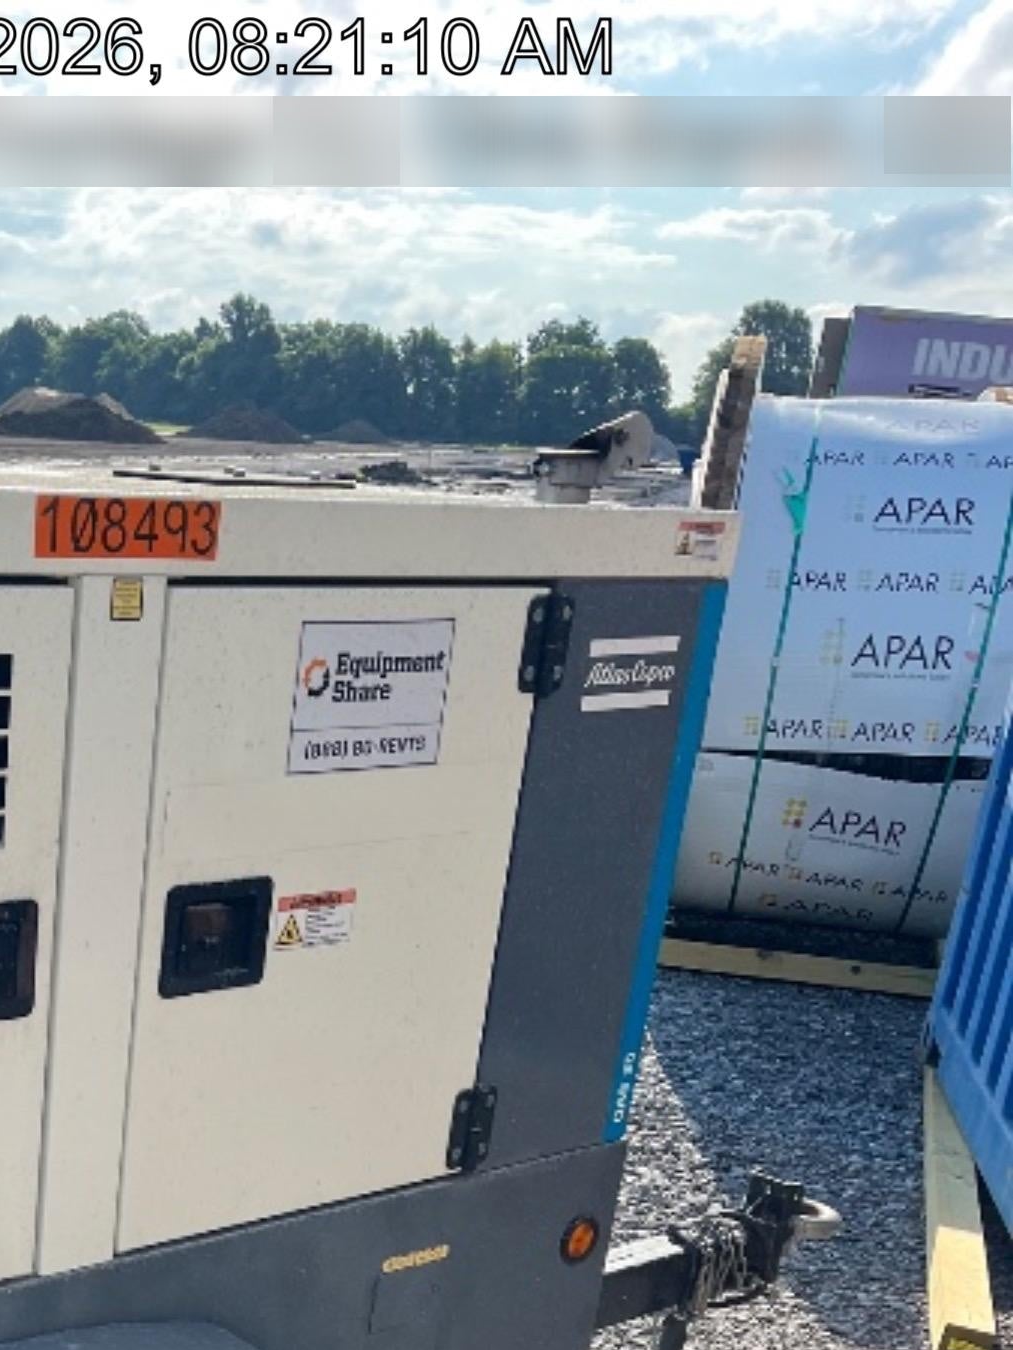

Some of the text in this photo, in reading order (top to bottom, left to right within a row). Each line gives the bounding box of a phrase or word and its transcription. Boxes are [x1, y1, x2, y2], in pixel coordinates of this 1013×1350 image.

[893, 451, 955, 469] APAR
[40, 495, 216, 556] 108493
[872, 496, 976, 526] APAR
[875, 571, 940, 593] APAR
[335, 650, 446, 679] Equipment
[850, 633, 955, 671] APAR
[331, 680, 393, 703] Share
[851, 721, 916, 743] APAR
[809, 806, 907, 848] APAR
